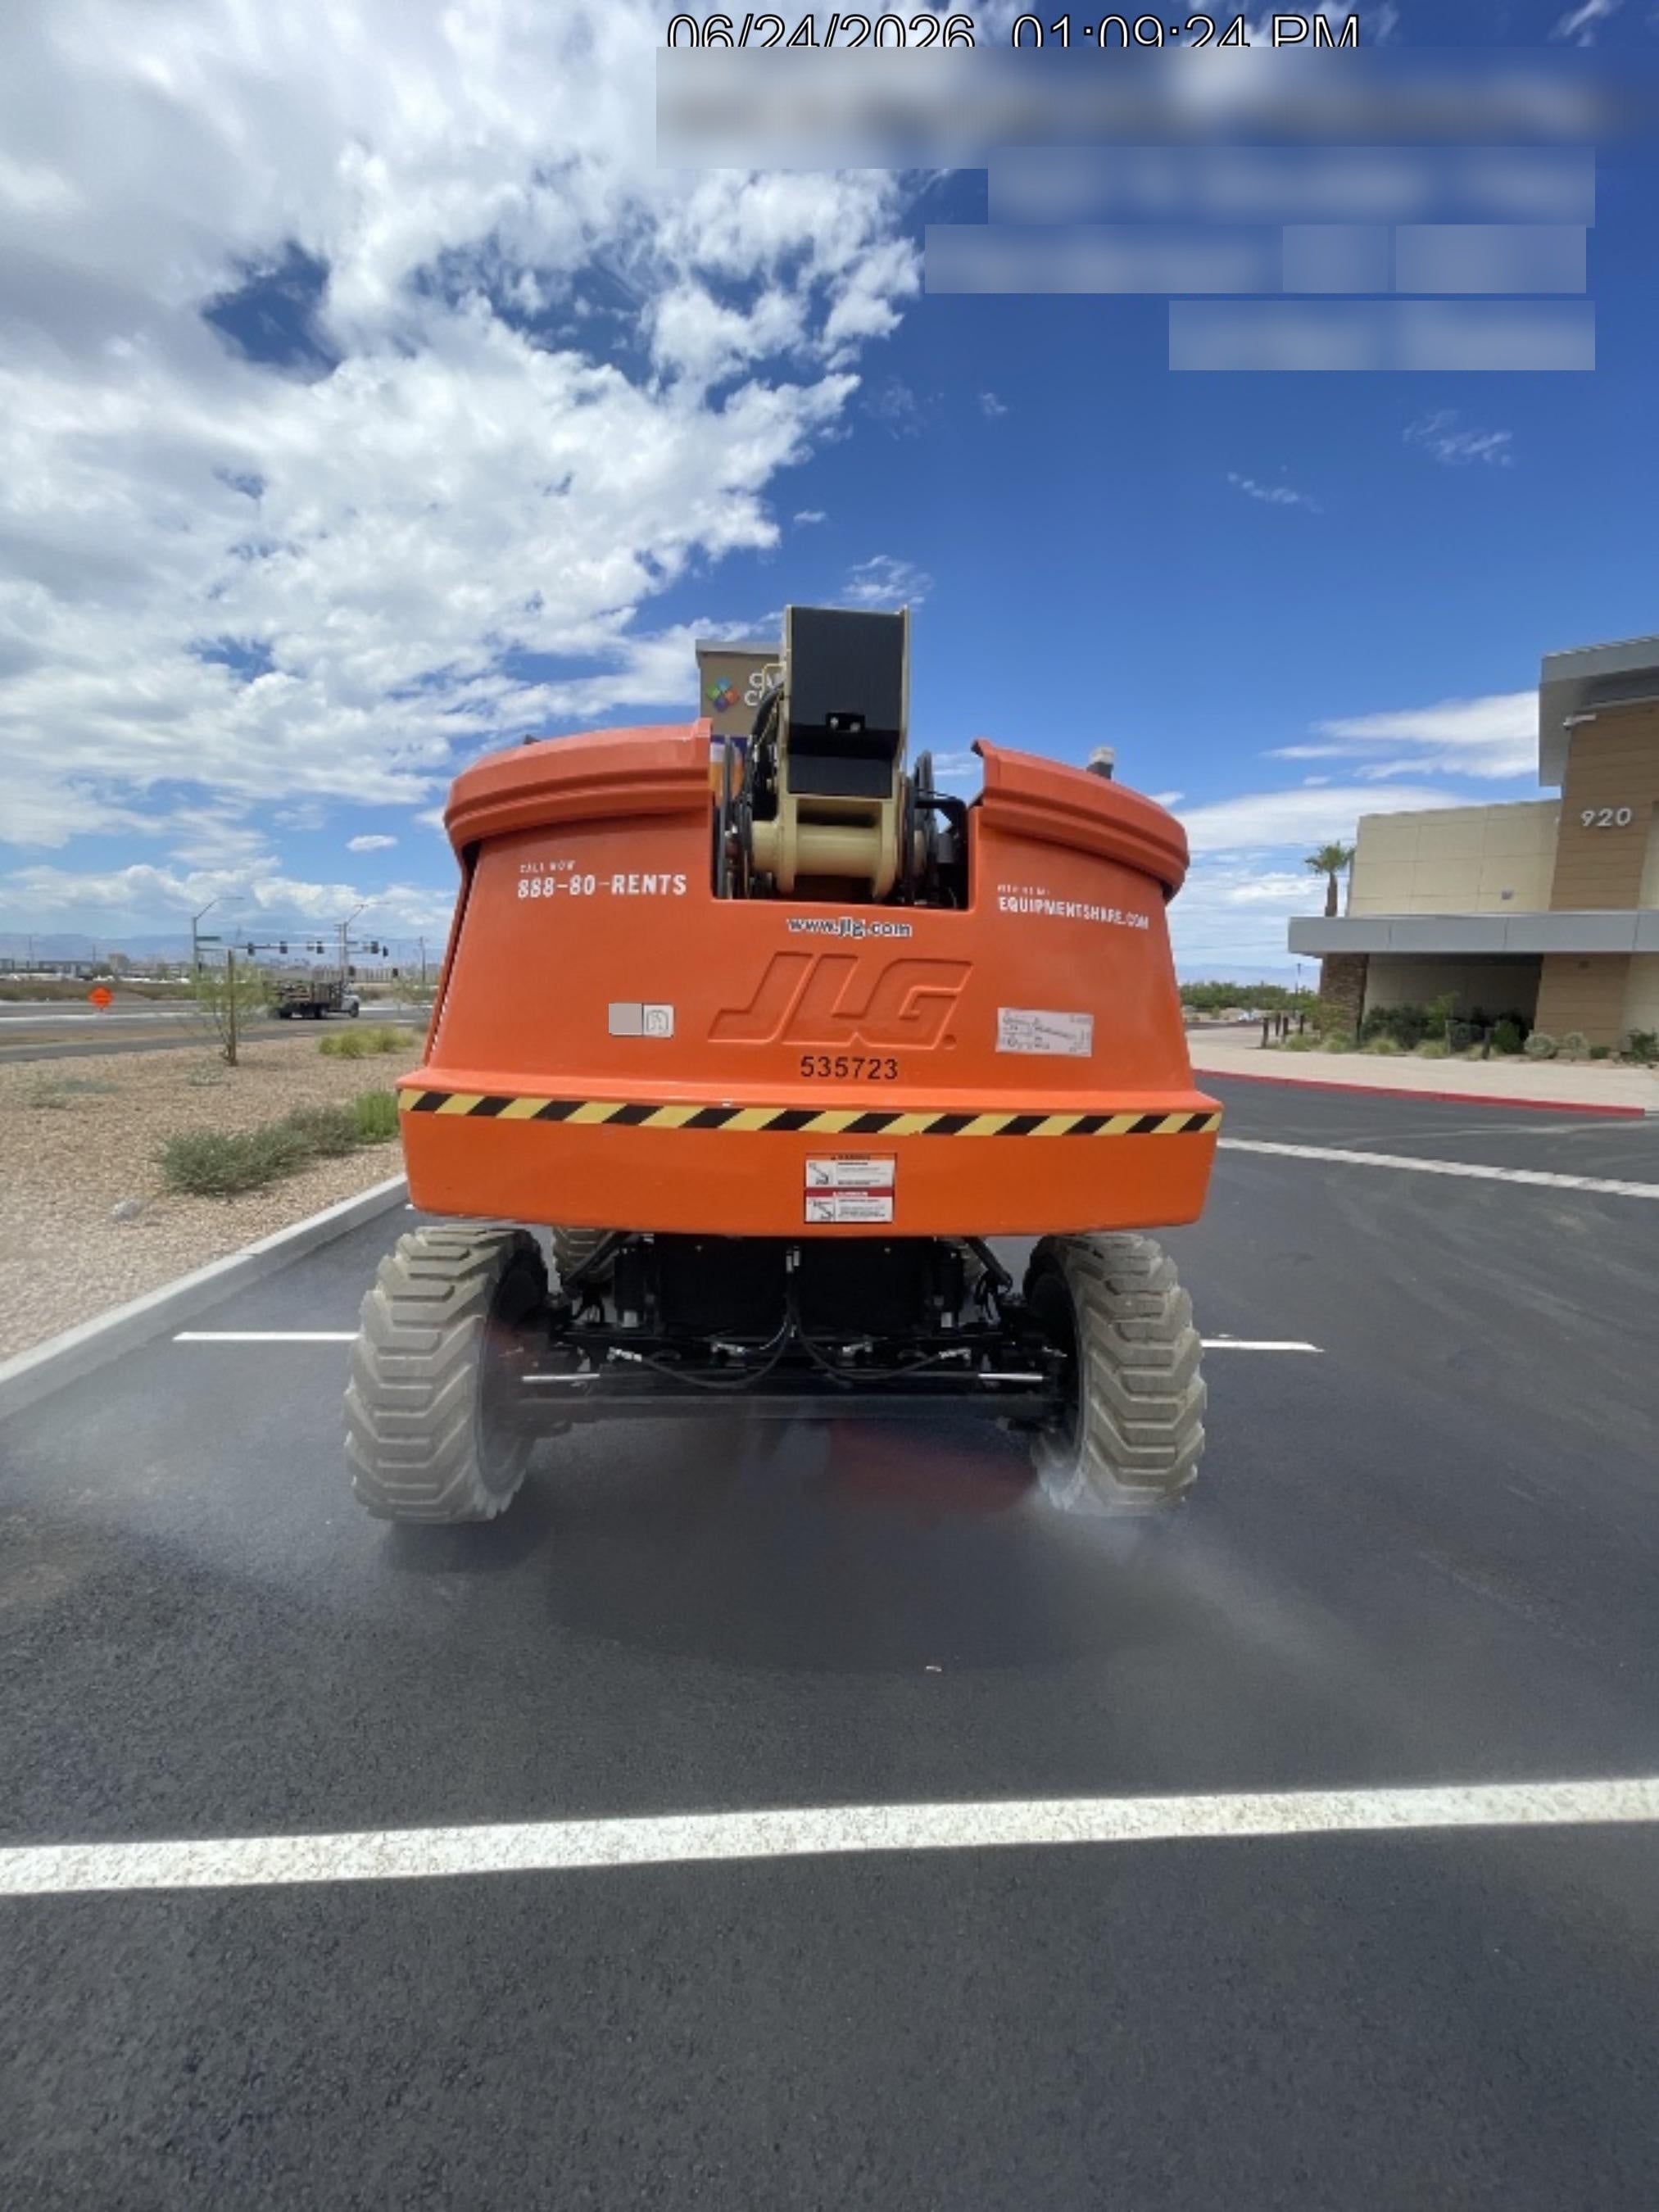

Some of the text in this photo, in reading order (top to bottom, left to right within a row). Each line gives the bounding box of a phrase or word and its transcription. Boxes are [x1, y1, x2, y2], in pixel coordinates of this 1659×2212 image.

[1580, 808, 1632, 827] 920
[786, 918, 913, 938] www.jlg.com
[707, 950, 973, 1050] JLG
[800, 1056, 899, 1081] 535723
